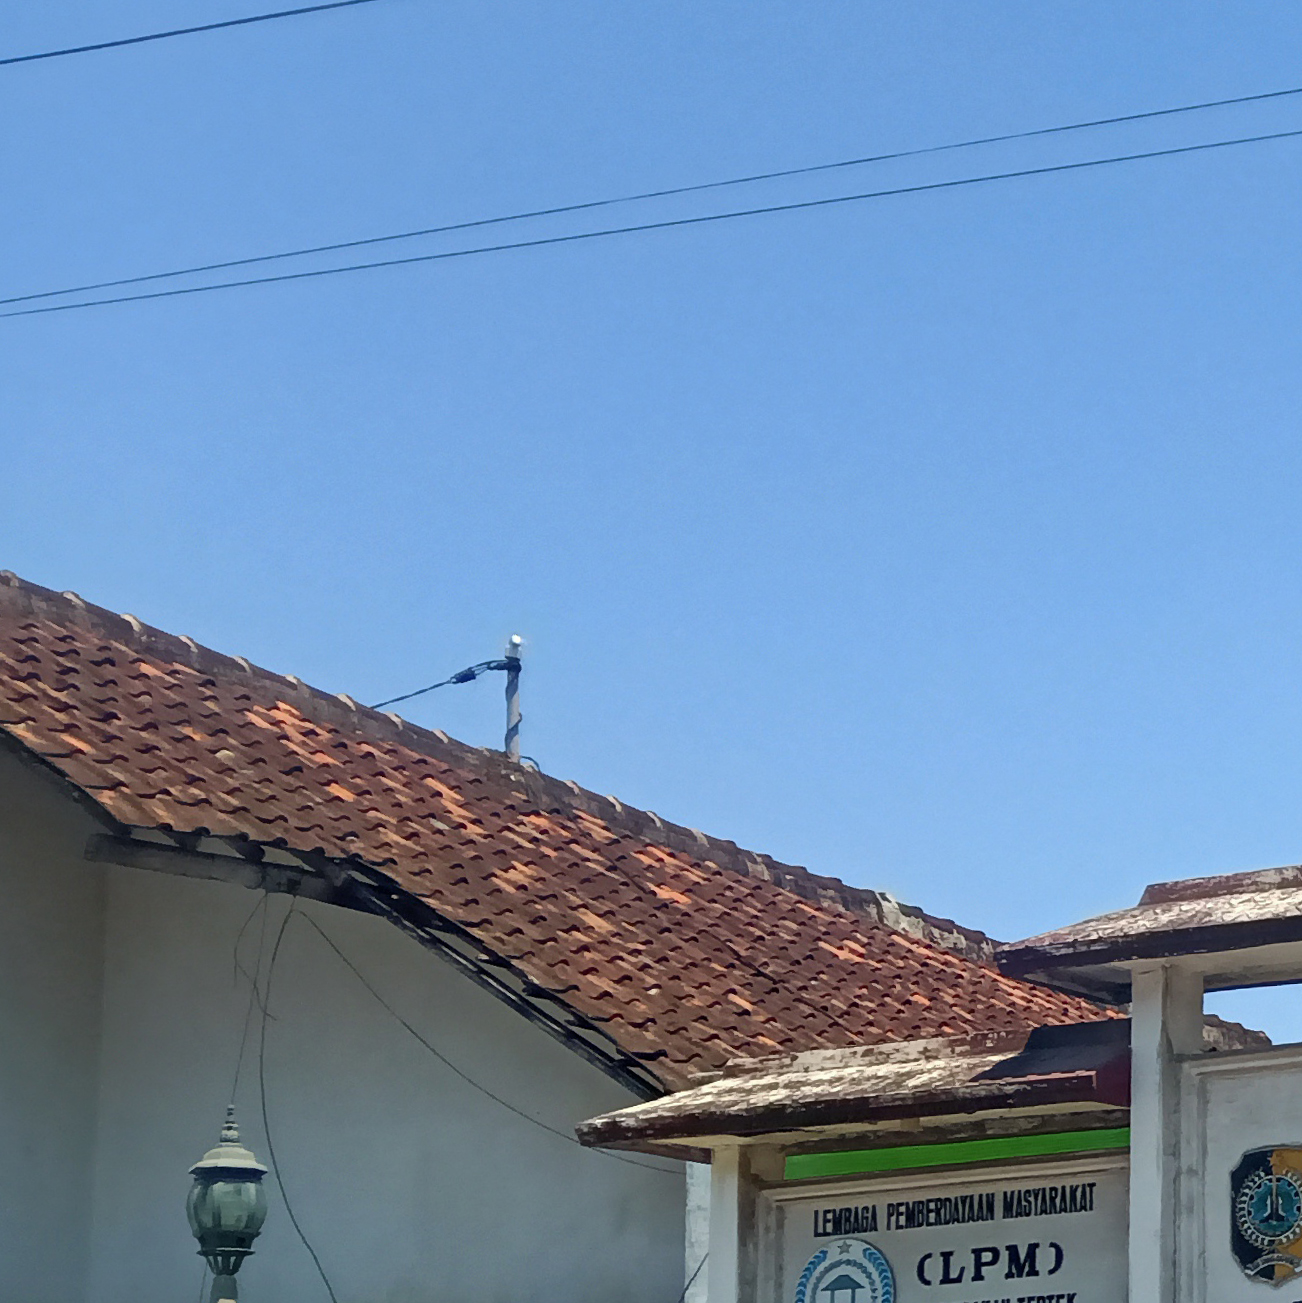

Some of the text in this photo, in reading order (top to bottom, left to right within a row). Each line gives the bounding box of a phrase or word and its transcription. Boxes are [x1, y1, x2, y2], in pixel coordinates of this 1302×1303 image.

[813, 1183, 1096, 1237] LEMBAGA PEMBERDAYAAN MASYARAKAT
[917, 1242, 1064, 1286] (LPM)
